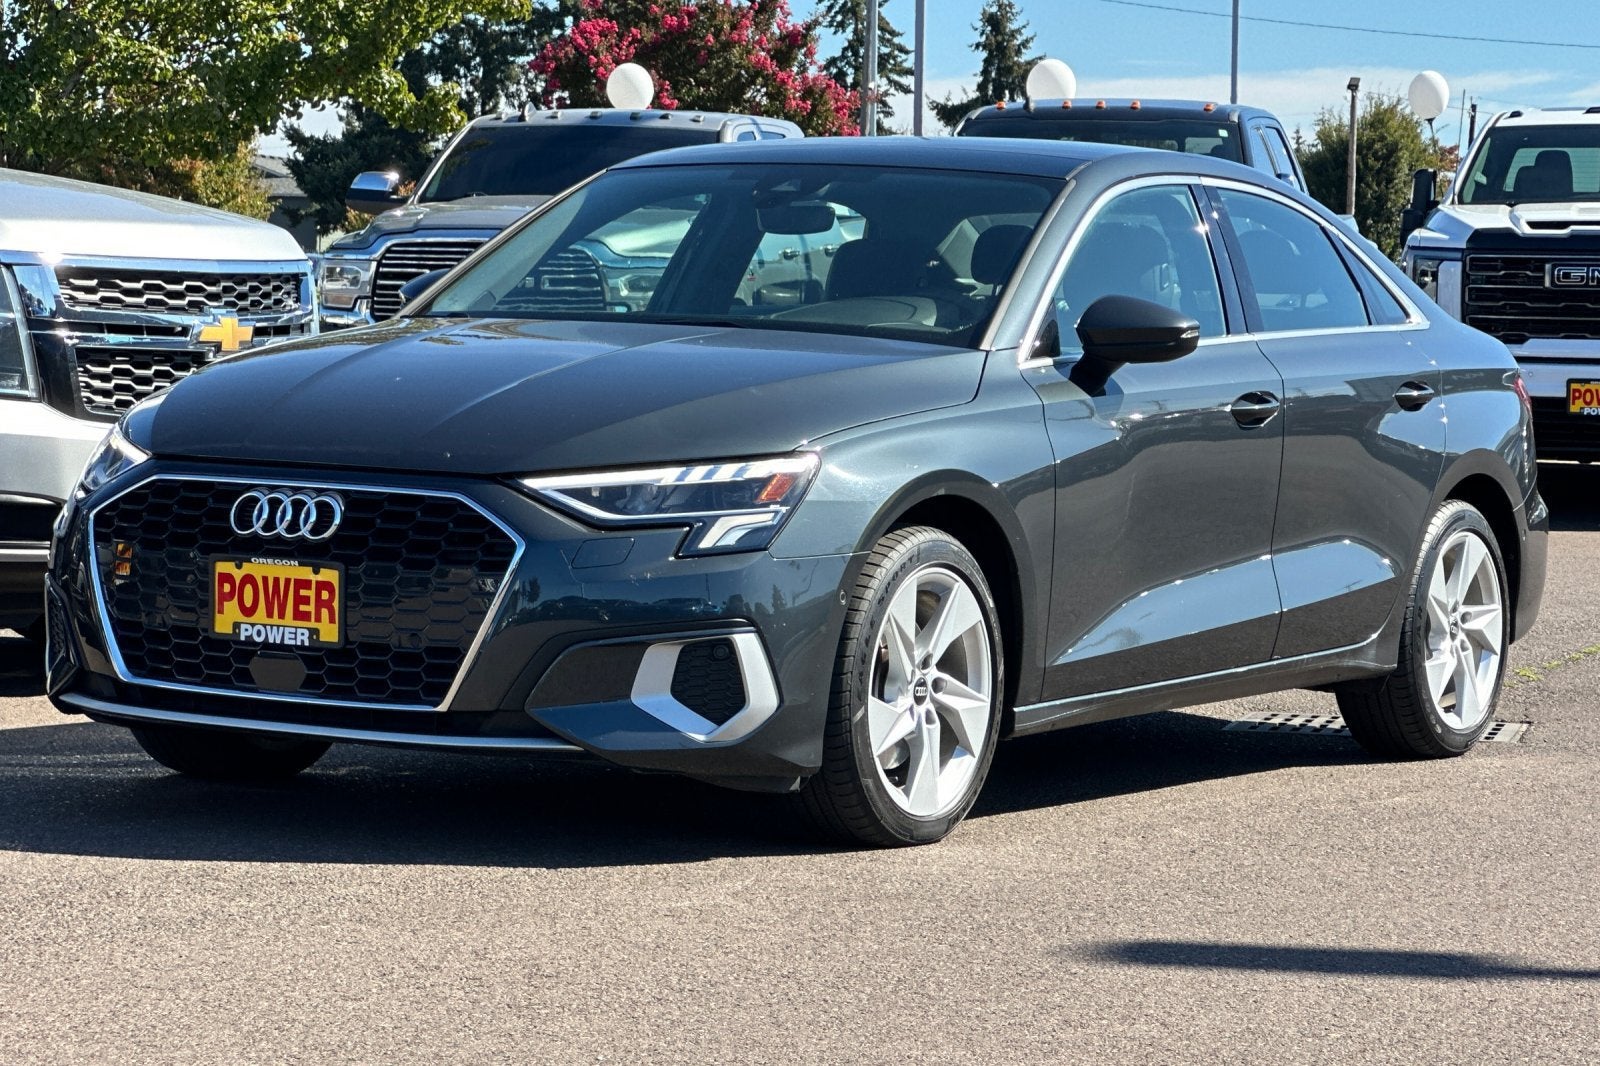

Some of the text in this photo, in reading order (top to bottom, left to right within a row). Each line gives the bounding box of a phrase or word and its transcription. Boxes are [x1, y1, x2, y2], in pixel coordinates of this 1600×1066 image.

[1583, 407, 1600, 416] PO
[250, 557, 299, 567] OREGON
[877, 554, 915, 606] SPORT
[217, 571, 337, 624] POWER
[239, 623, 310, 647] POWER
